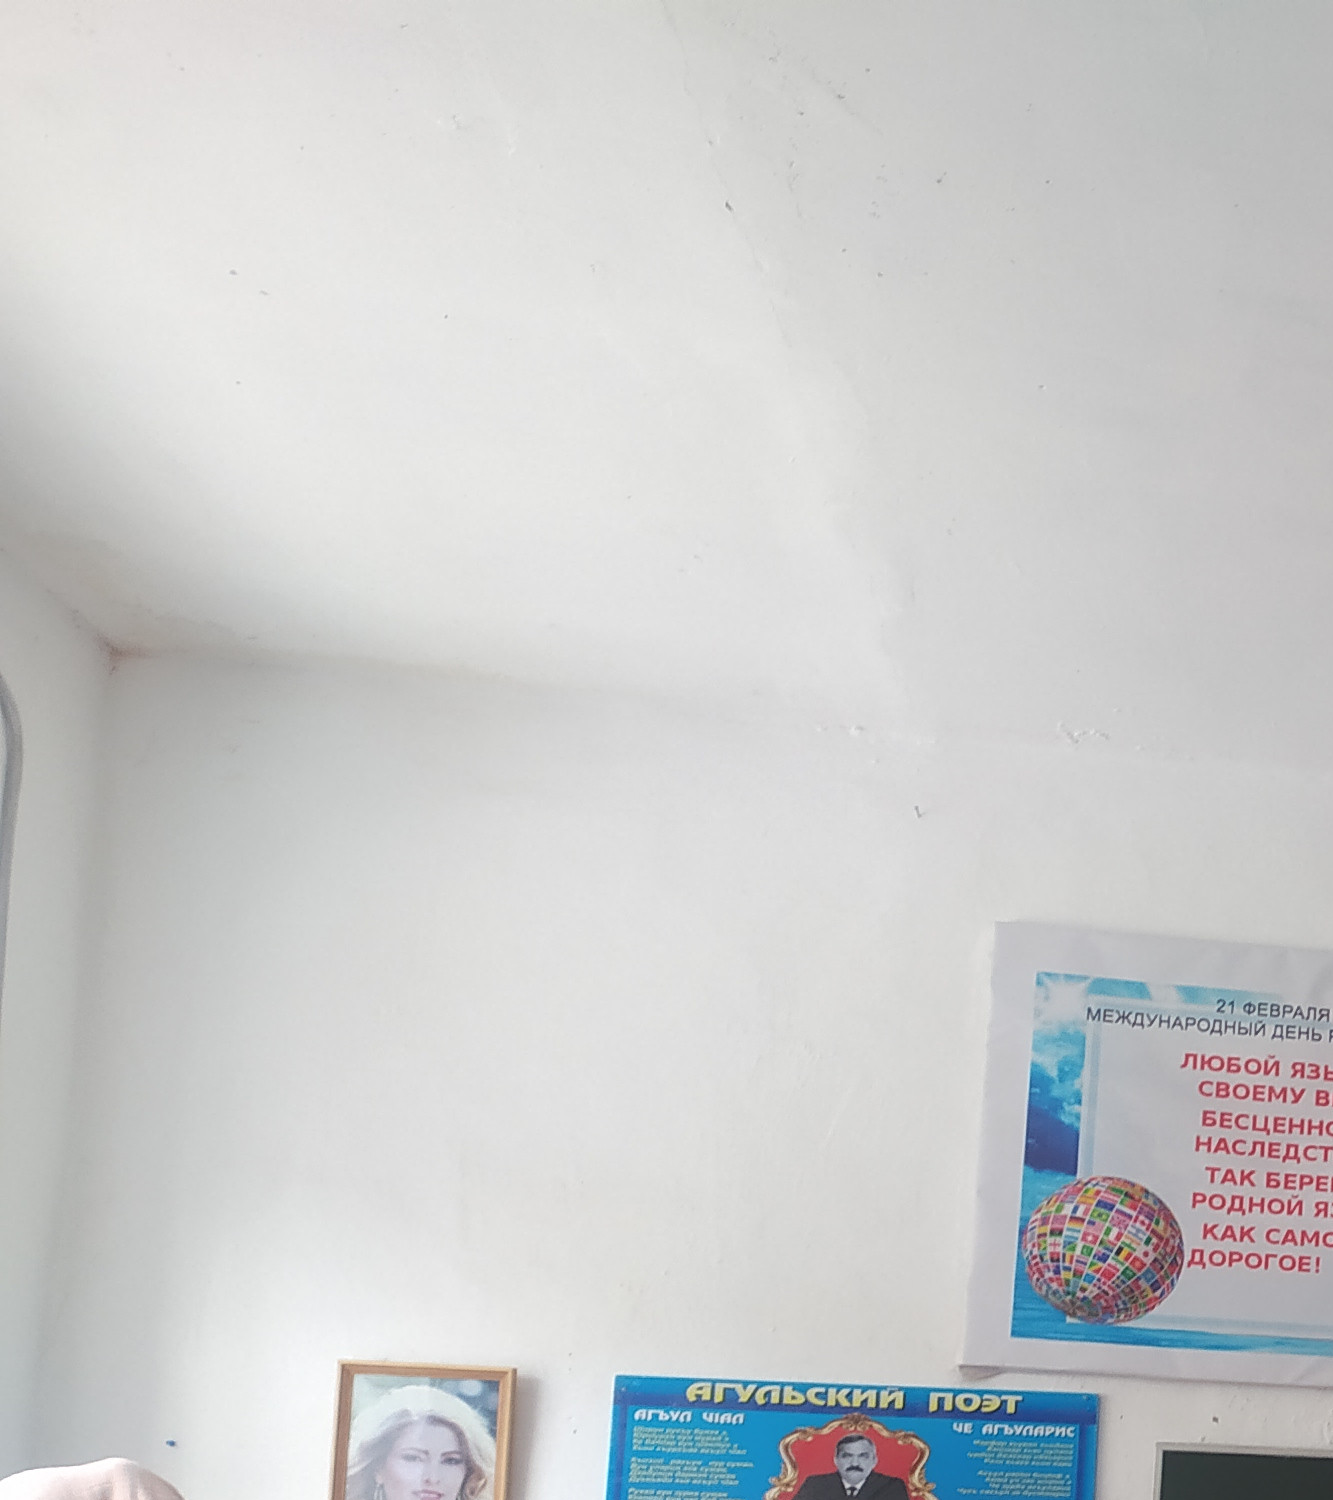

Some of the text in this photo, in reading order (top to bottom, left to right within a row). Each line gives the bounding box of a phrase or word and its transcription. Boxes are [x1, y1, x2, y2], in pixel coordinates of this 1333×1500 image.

[1216, 999, 1331, 1022] 21 ФЕВРАЛЯ
[1086, 1007, 1266, 1038] МЕЖДУНАРОДНЫЙ
[1271, 1024, 1323, 1042] ДЕНЬ
[1180, 1053, 1281, 1077] ЛЮБОЙ
[1198, 1080, 1306, 1104] СВОЕМУ
[1205, 1166, 1256, 1187] ТАК
[1192, 1192, 1303, 1216] РОДНОЙ
[1202, 1223, 1256, 1243] КАК
[1187, 1249, 1320, 1274] ДОРОГОЕ!
[686, 1382, 1023, 1414] АГУЛЬСКИЙ ПОЭТ
[634, 1409, 692, 1422] АГЪУЛ
[953, 1421, 1076, 1438] ЧЕ АГЪУЛАРИС
